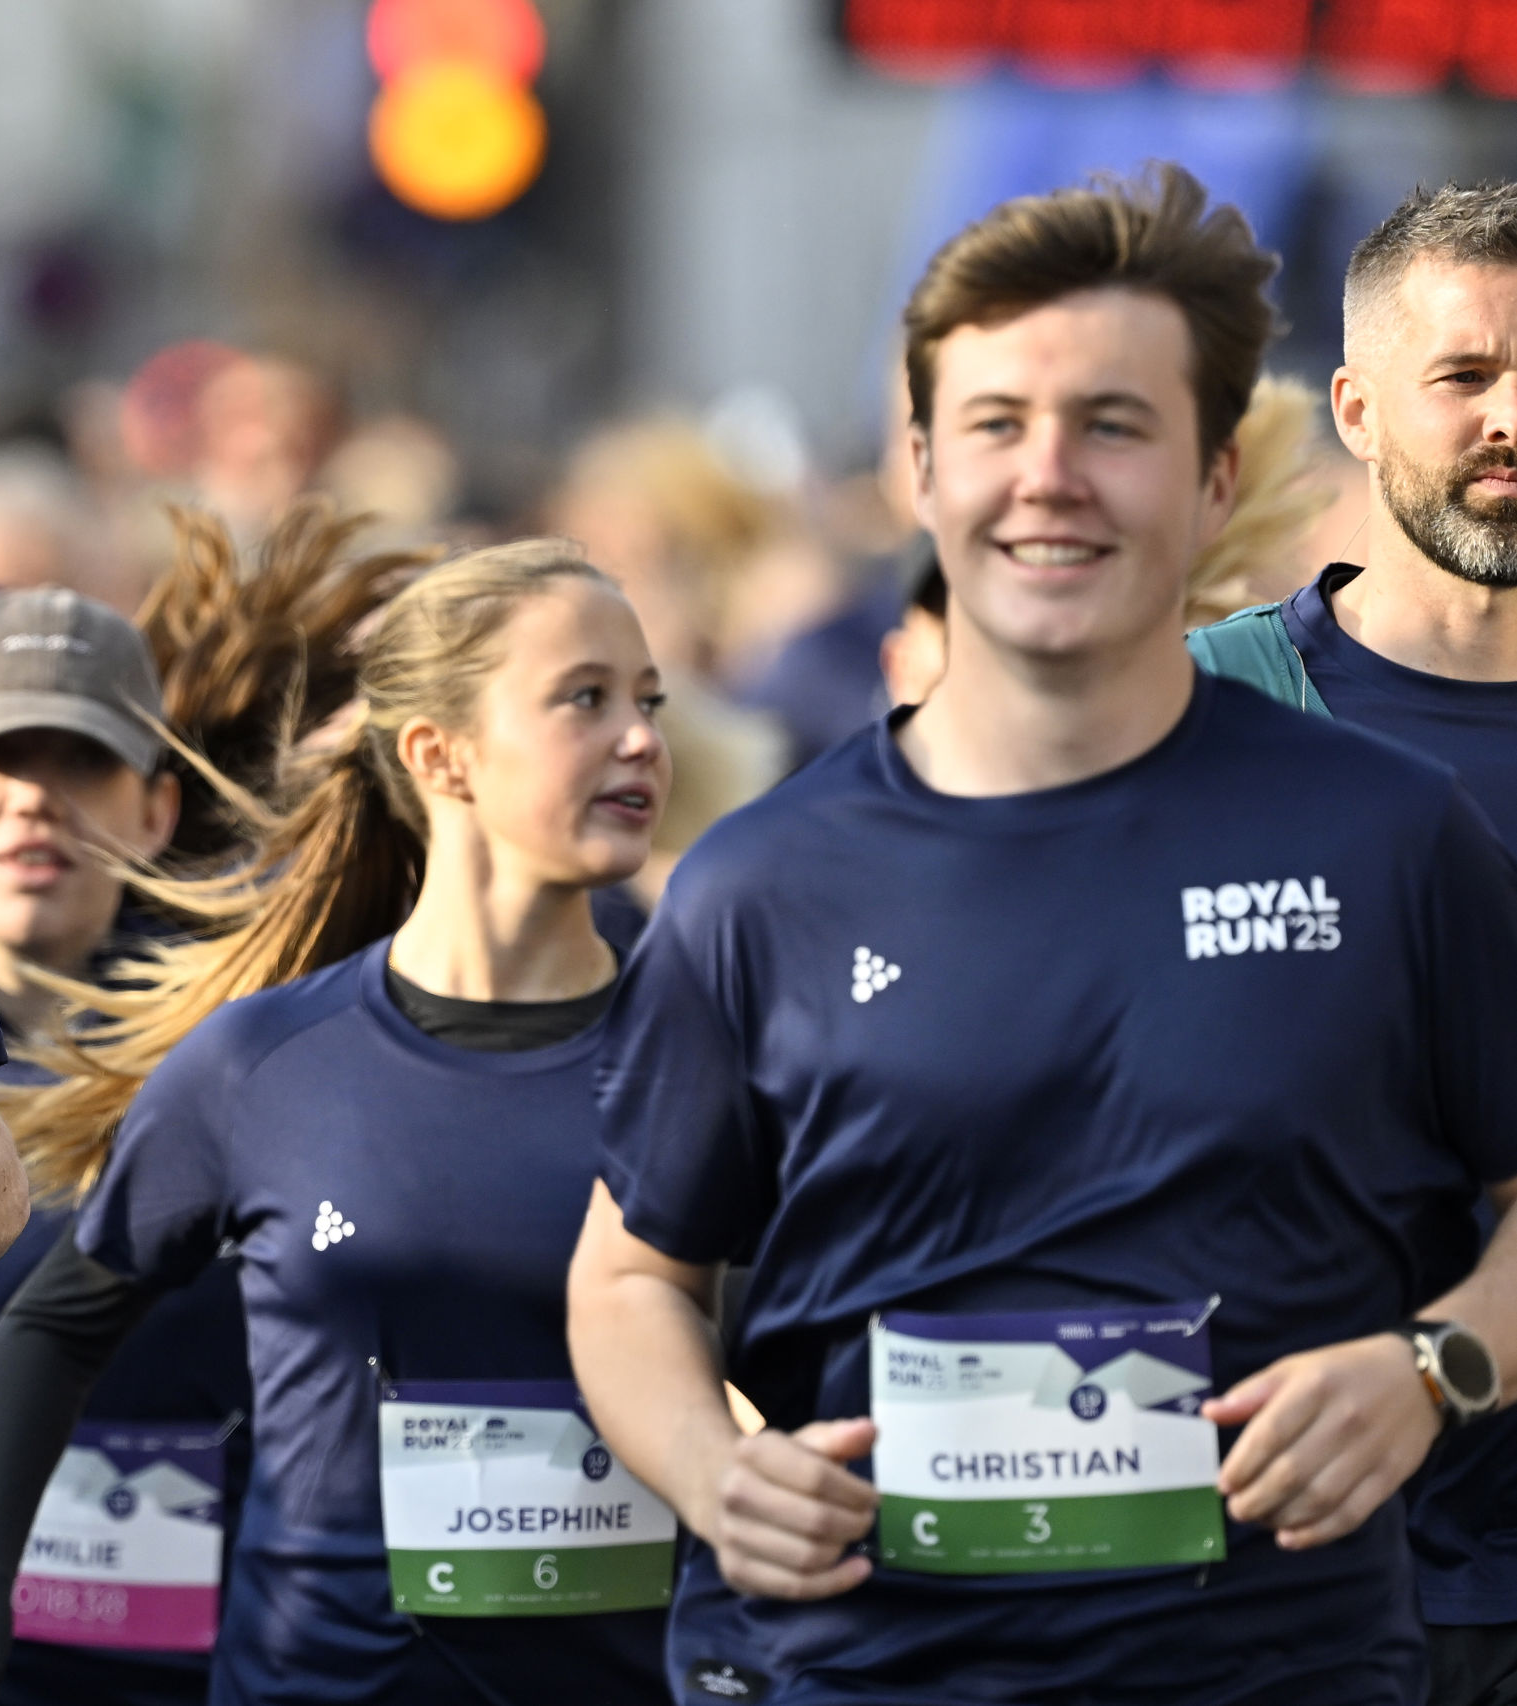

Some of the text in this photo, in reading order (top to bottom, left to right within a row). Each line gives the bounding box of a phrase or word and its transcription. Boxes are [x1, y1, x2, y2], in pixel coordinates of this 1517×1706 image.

[1181, 875, 1341, 923] ROYAL
[930, 1447, 1141, 1482] CHRISTIAN
[447, 1503, 633, 1534] JOSEPHINE
[912, 1503, 1051, 1546] C 3
[33, 1539, 122, 1569] MILIE
[427, 1554, 559, 1593] C 6
